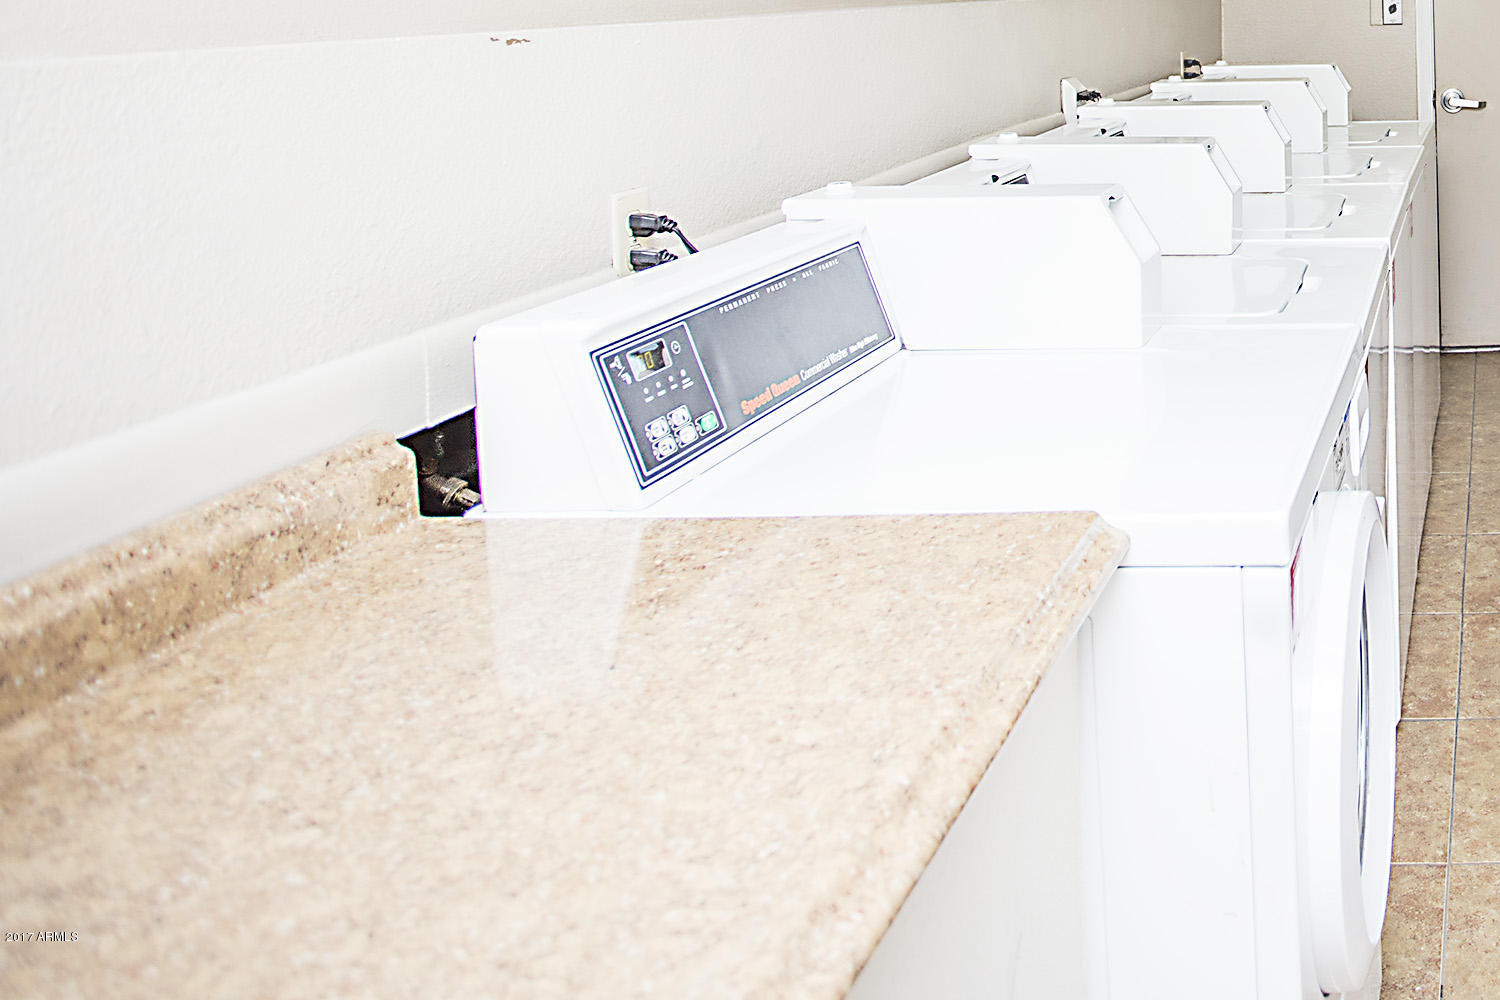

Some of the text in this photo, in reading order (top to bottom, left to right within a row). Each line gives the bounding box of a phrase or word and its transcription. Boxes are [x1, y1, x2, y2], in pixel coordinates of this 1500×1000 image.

[765, 280, 788, 295] PRESS
[801, 269, 815, 279] ALL
[740, 387, 773, 416] Speed
[770, 373, 802, 398] Queen
[799, 356, 831, 382] Commercial
